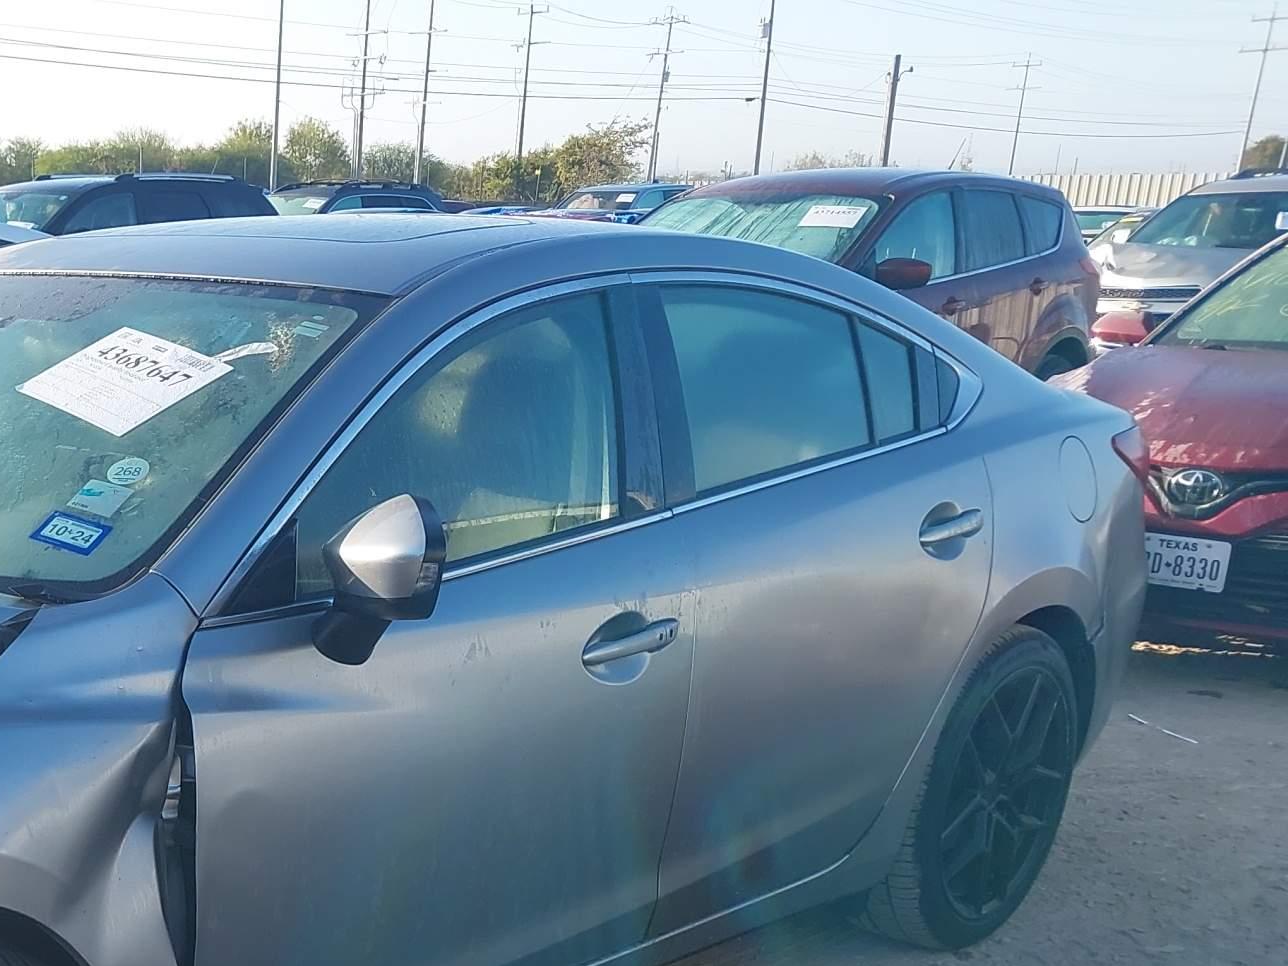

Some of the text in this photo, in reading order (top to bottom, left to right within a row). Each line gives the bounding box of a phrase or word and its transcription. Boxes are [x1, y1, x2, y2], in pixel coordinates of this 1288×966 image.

[98, 345, 193, 387] 43687647
[114, 466, 143, 477] 268
[1159, 538, 1199, 552] TEXAS
